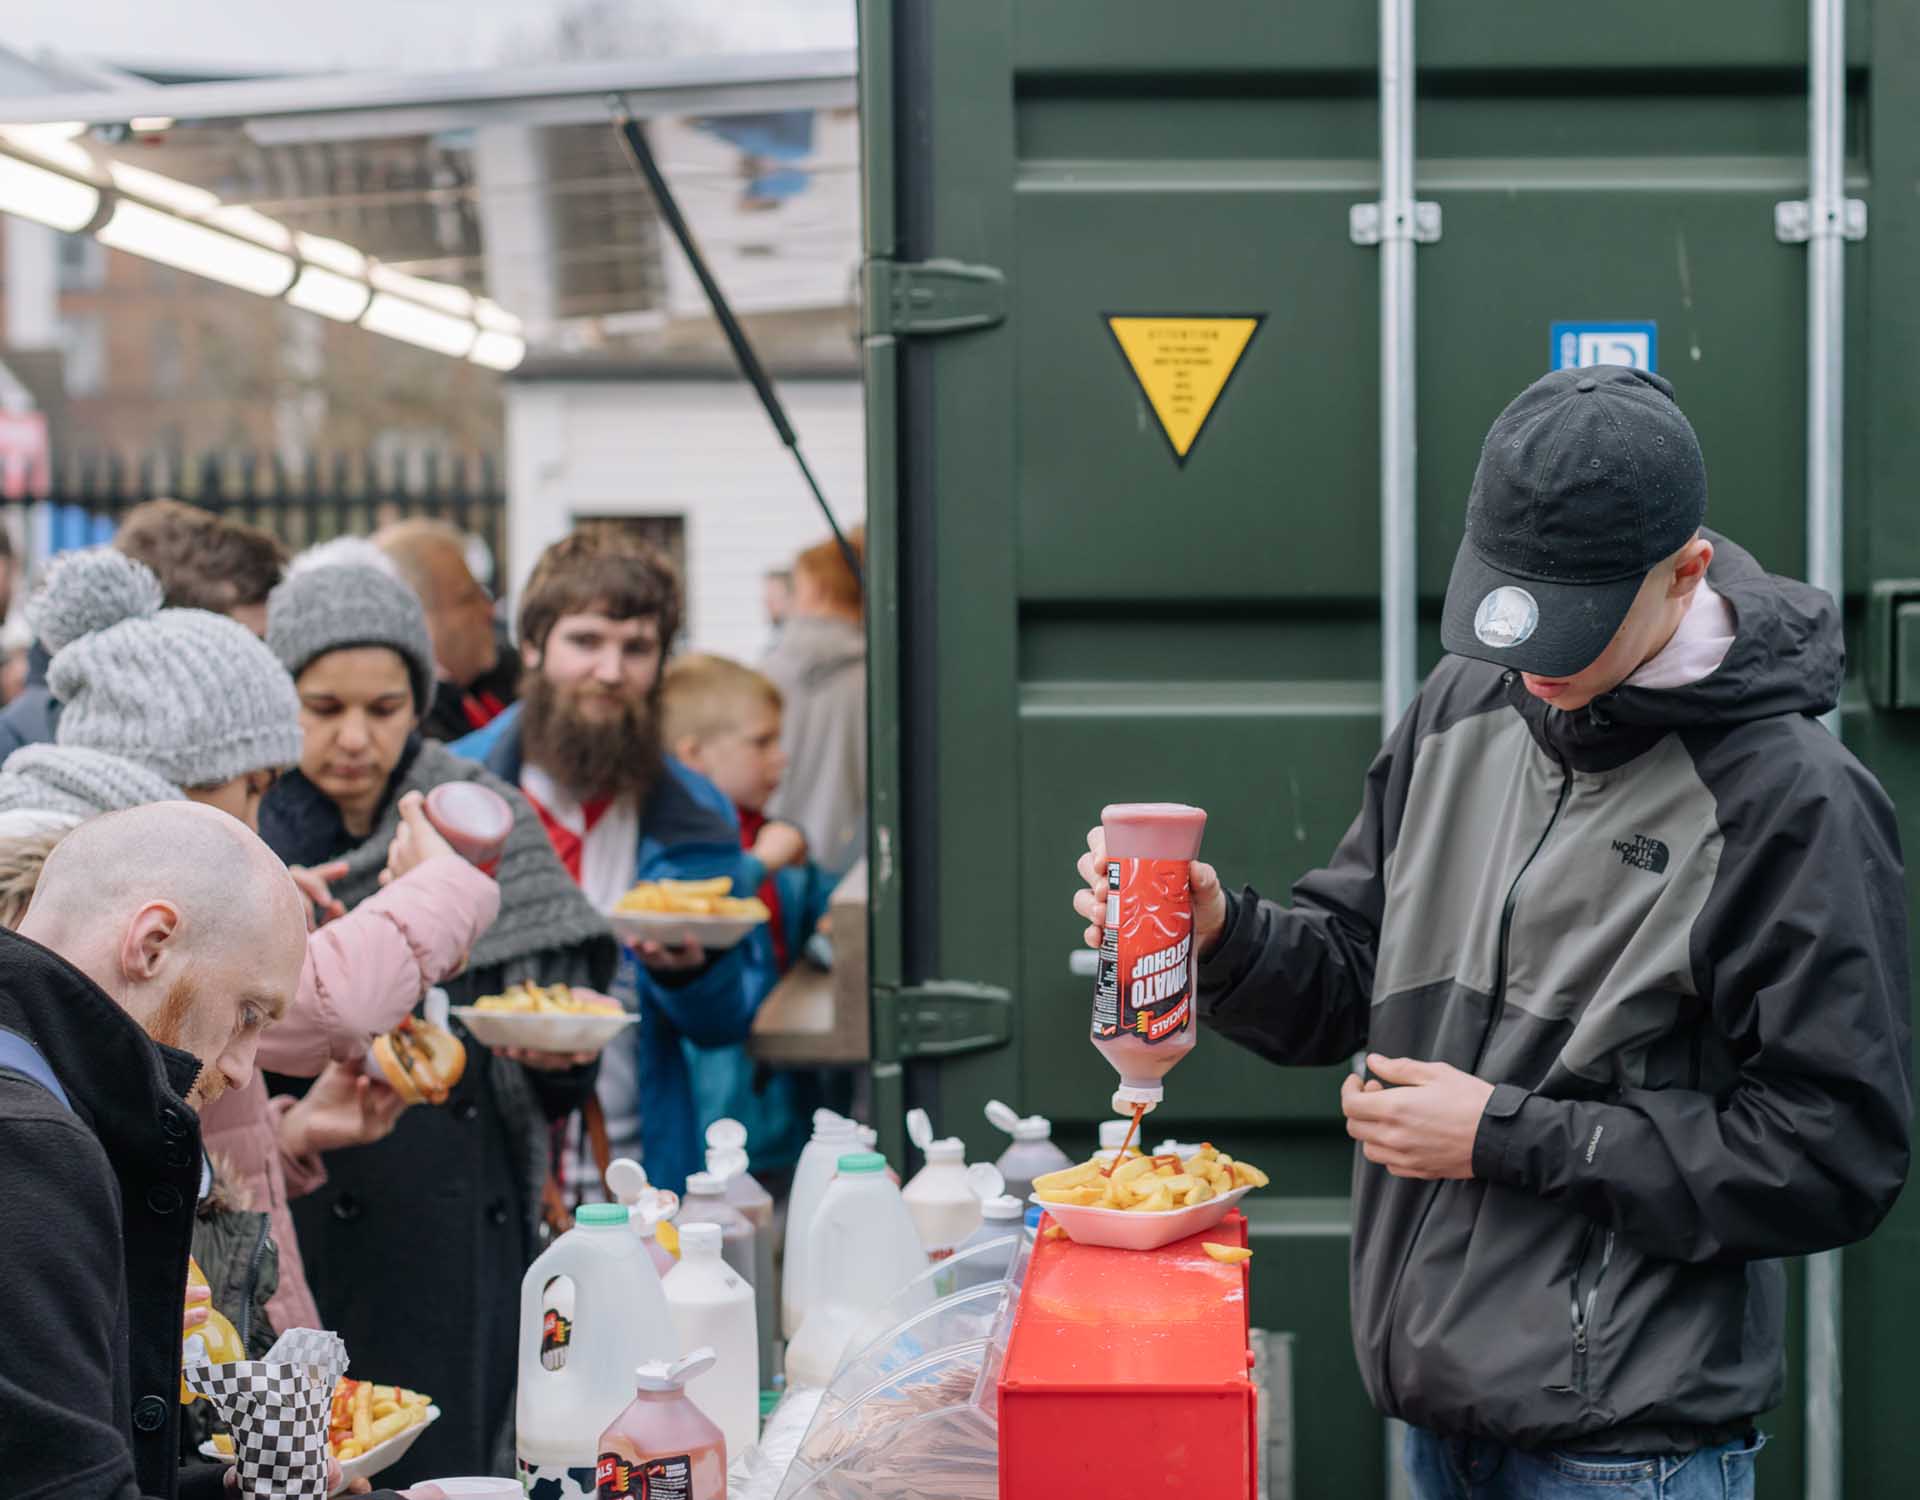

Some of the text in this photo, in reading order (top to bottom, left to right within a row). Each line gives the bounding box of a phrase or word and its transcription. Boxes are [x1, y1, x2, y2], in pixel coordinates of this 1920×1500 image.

[1611, 839, 1652, 859] NORTH
[1634, 834, 1659, 850] THE
[1621, 855, 1651, 870] FACE
